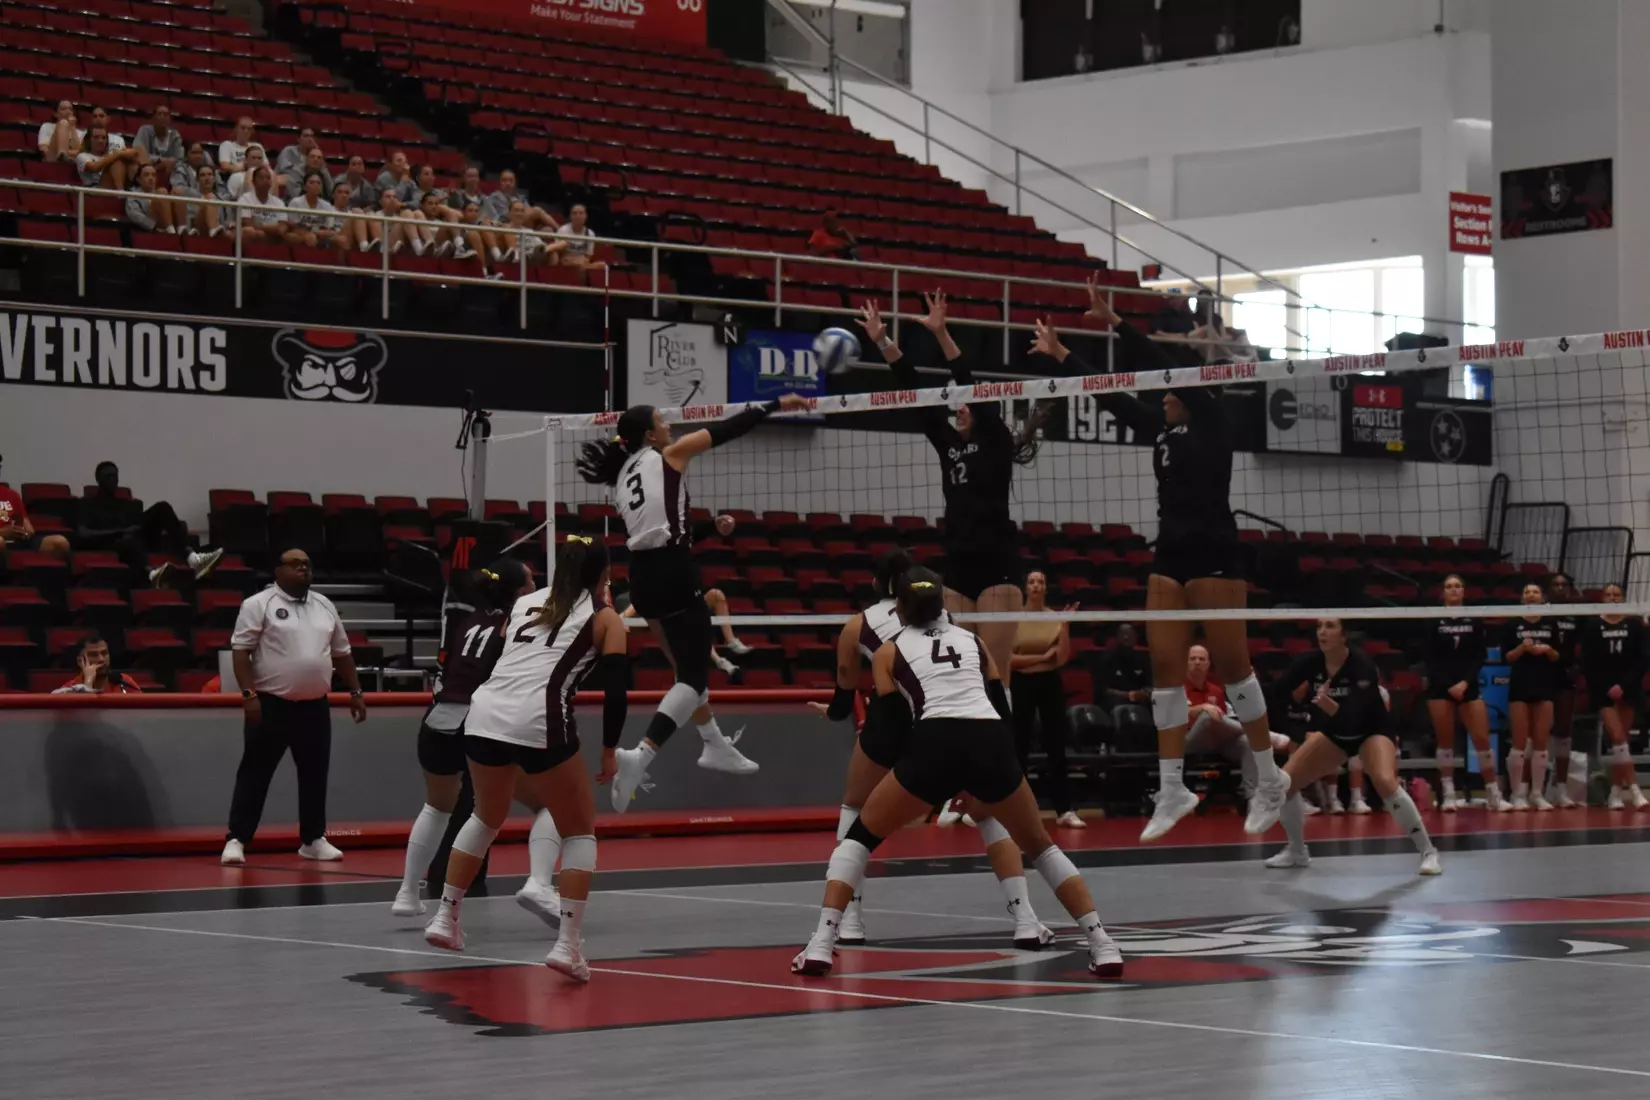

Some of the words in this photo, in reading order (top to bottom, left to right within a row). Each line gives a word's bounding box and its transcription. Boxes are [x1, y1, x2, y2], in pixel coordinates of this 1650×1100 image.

[559, 8, 582, 22] Your
[583, 11, 637, 29] Statement
[657, 336, 695, 357] RIVER
[1603, 331, 1643, 349] AUSTIN
[0, 313, 226, 391] VERNORS
[1460, 345, 1496, 360] AUSTIN
[1499, 341, 1524, 357] PEAY
[667, 351, 696, 371] CLUB
[1325, 357, 1359, 371] AUSTIN
[1362, 354, 1385, 368] PEAY
[1083, 376, 1113, 390] AUSTIN
[1115, 373, 1135, 387] PEAY
[1200, 366, 1232, 381] AUSTIN
[1235, 364, 1255, 378] PEAY
[871, 391, 896, 405] AUSTIN
[899, 390, 916, 404] PEAY
[973, 384, 1001, 398] AUSTIN
[1003, 382, 1022, 396] PEAY
[683, 406, 706, 420] AUSTIN
[708, 404, 723, 418] PEAY
[1352, 407, 1404, 428] PROTECT
[1352, 427, 1372, 442] THIS
[1159, 444, 1170, 468] 2
[950, 462, 968, 484] 12
[627, 473, 645, 511] 3
[461, 624, 495, 658] 11
[1609, 639, 1623, 654] 14
[931, 639, 961, 668] 4
